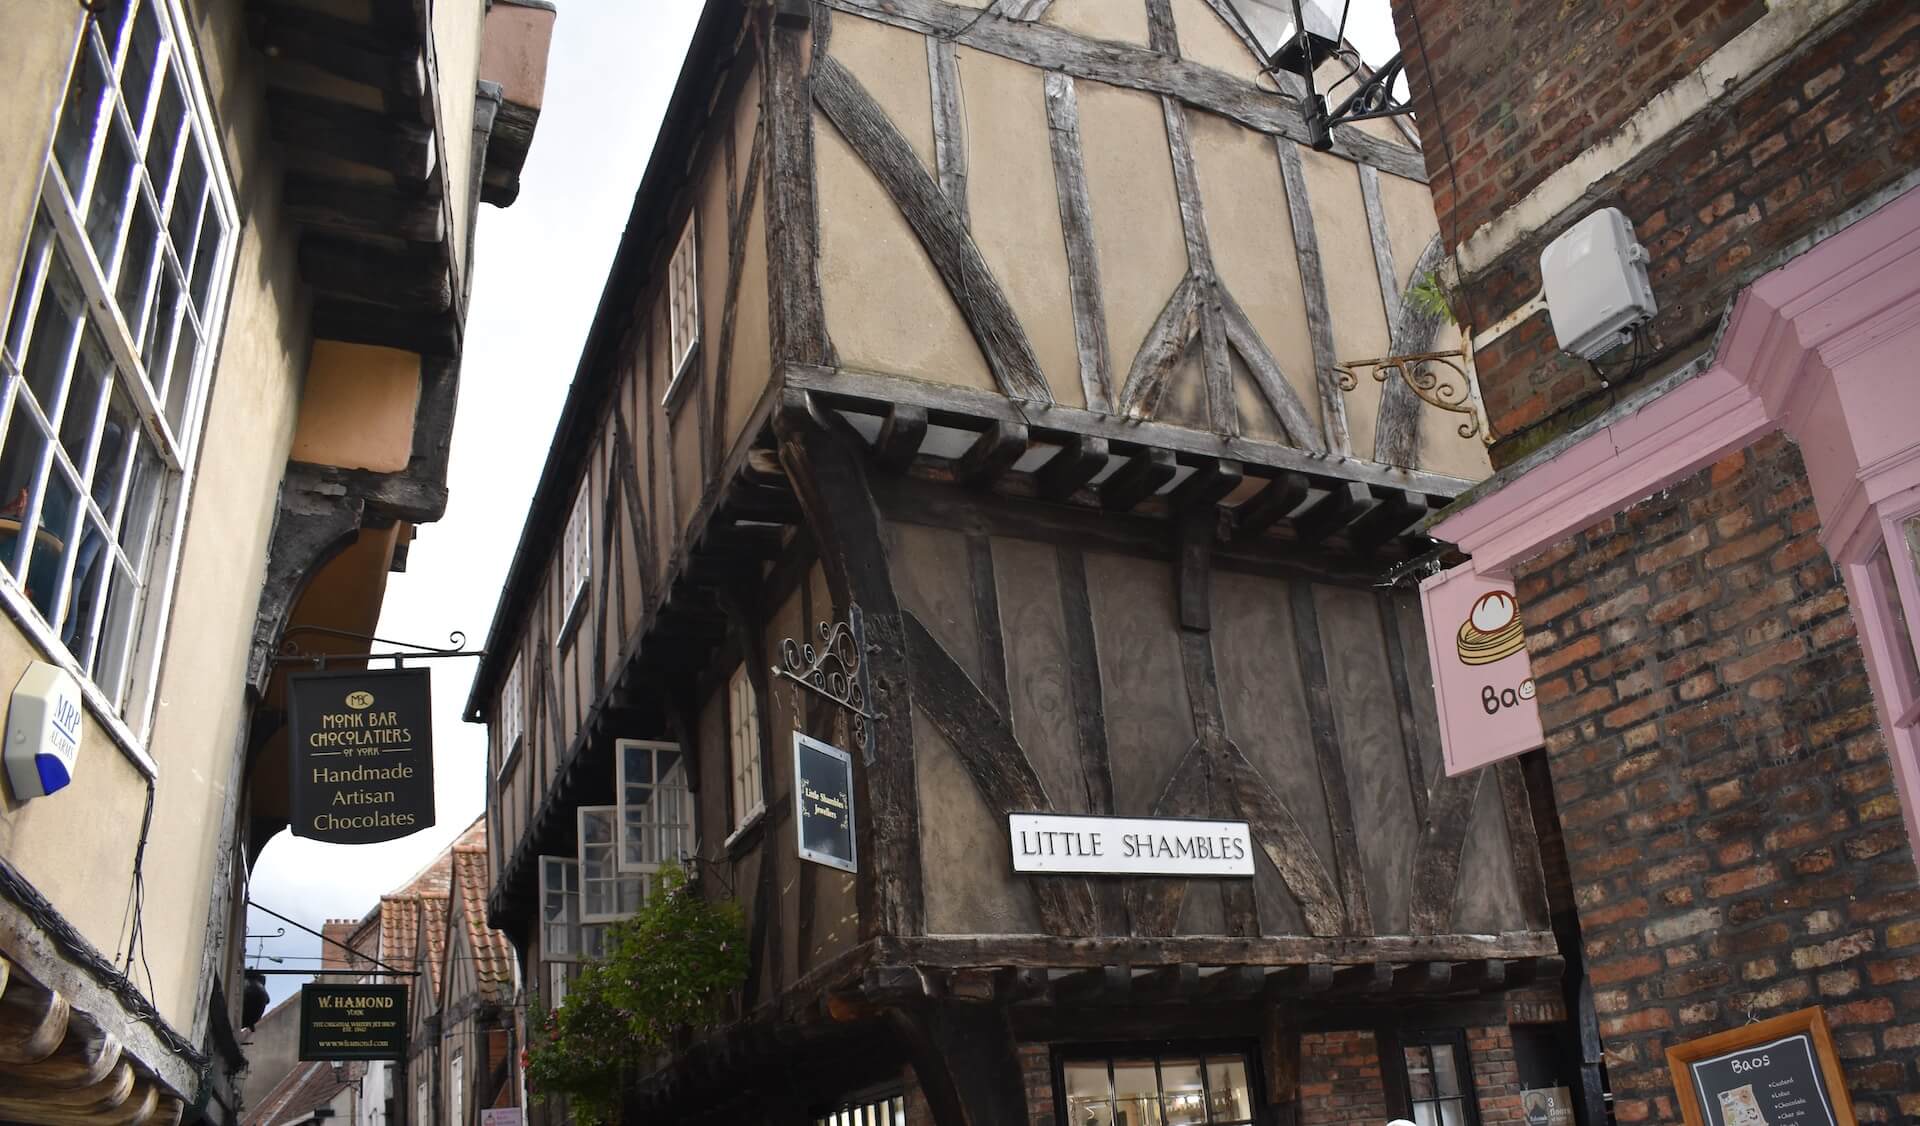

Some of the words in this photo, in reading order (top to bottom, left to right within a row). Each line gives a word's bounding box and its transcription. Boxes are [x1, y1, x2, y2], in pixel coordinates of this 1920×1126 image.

[54, 693, 81, 734] MRP
[322, 713, 364, 729] MONK
[369, 711, 398, 727] BAR
[50, 730, 74, 761] ALARMS
[310, 728, 412, 748] CHOCOLATIERS
[357, 747, 380, 756] YORK
[313, 763, 413, 784] Handmade
[332, 789, 395, 806] Artisan
[805, 787, 819, 801] Little
[820, 793, 845, 809] Shambles
[314, 811, 415, 831] Chocolates
[1021, 831, 1104, 857] LITTLE
[1122, 834, 1245, 860] SHAMBLES
[335, 997, 394, 1008] HAMOND
[1730, 1054, 1771, 1074] Baos
[1547, 1097, 1554, 1108] 3
